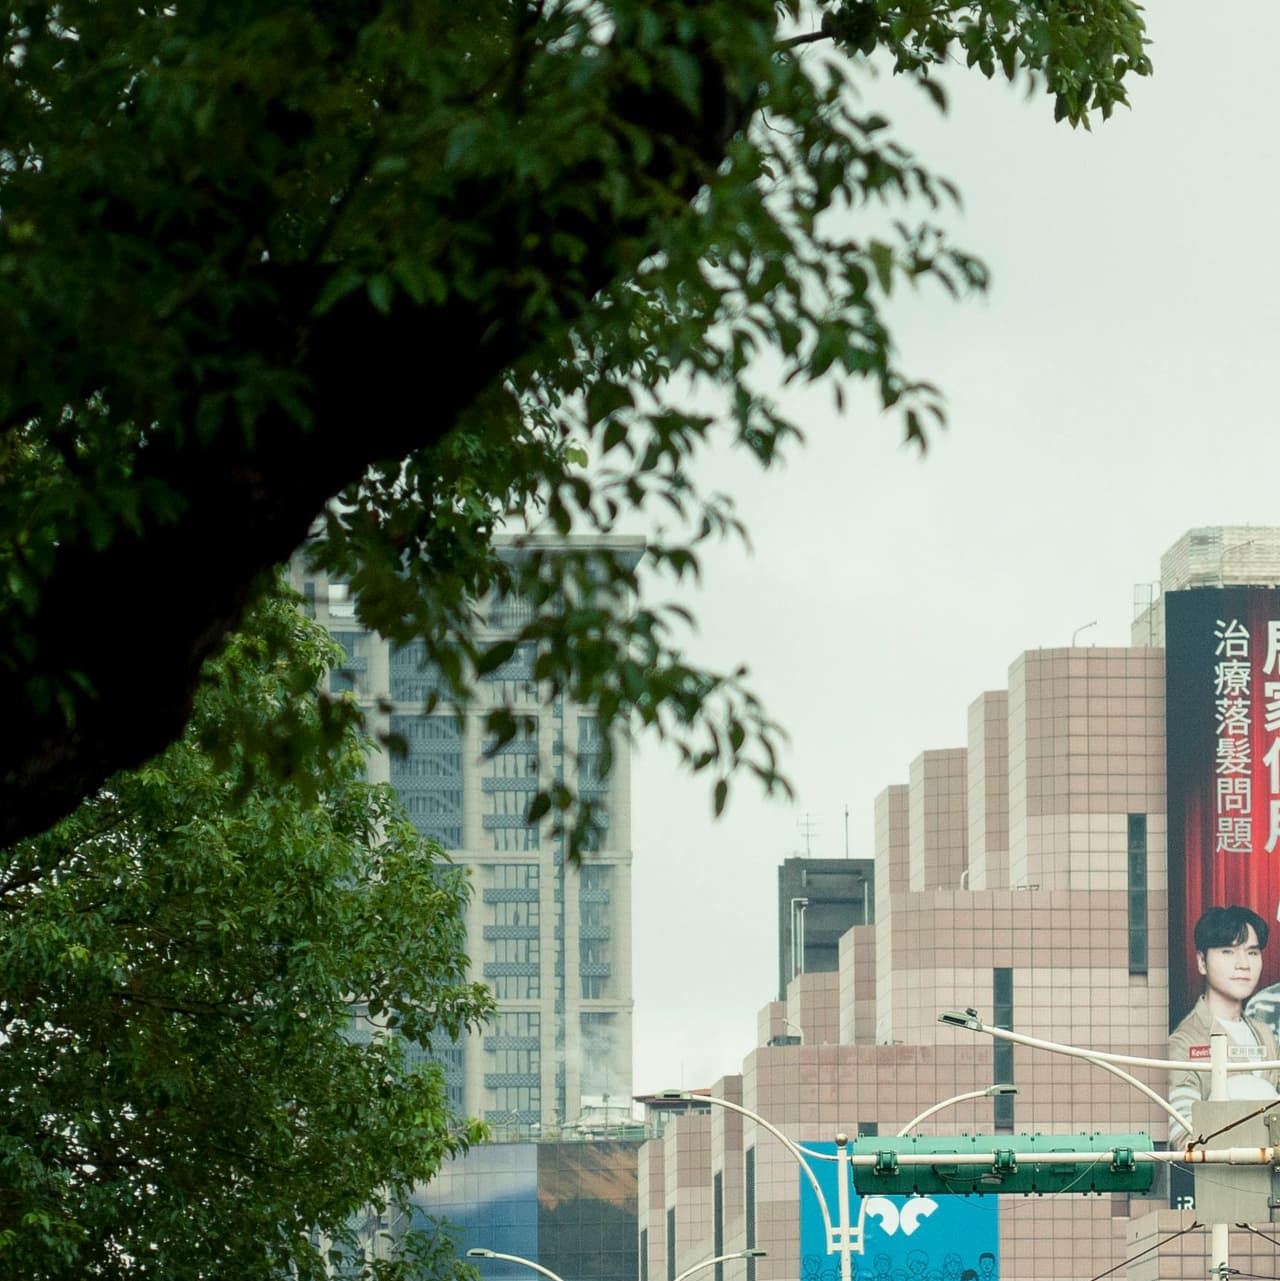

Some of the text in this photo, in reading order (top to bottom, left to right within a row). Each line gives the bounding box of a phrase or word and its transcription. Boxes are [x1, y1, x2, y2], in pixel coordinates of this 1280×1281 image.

[1213, 618, 1253, 853] 治療落髮問題
